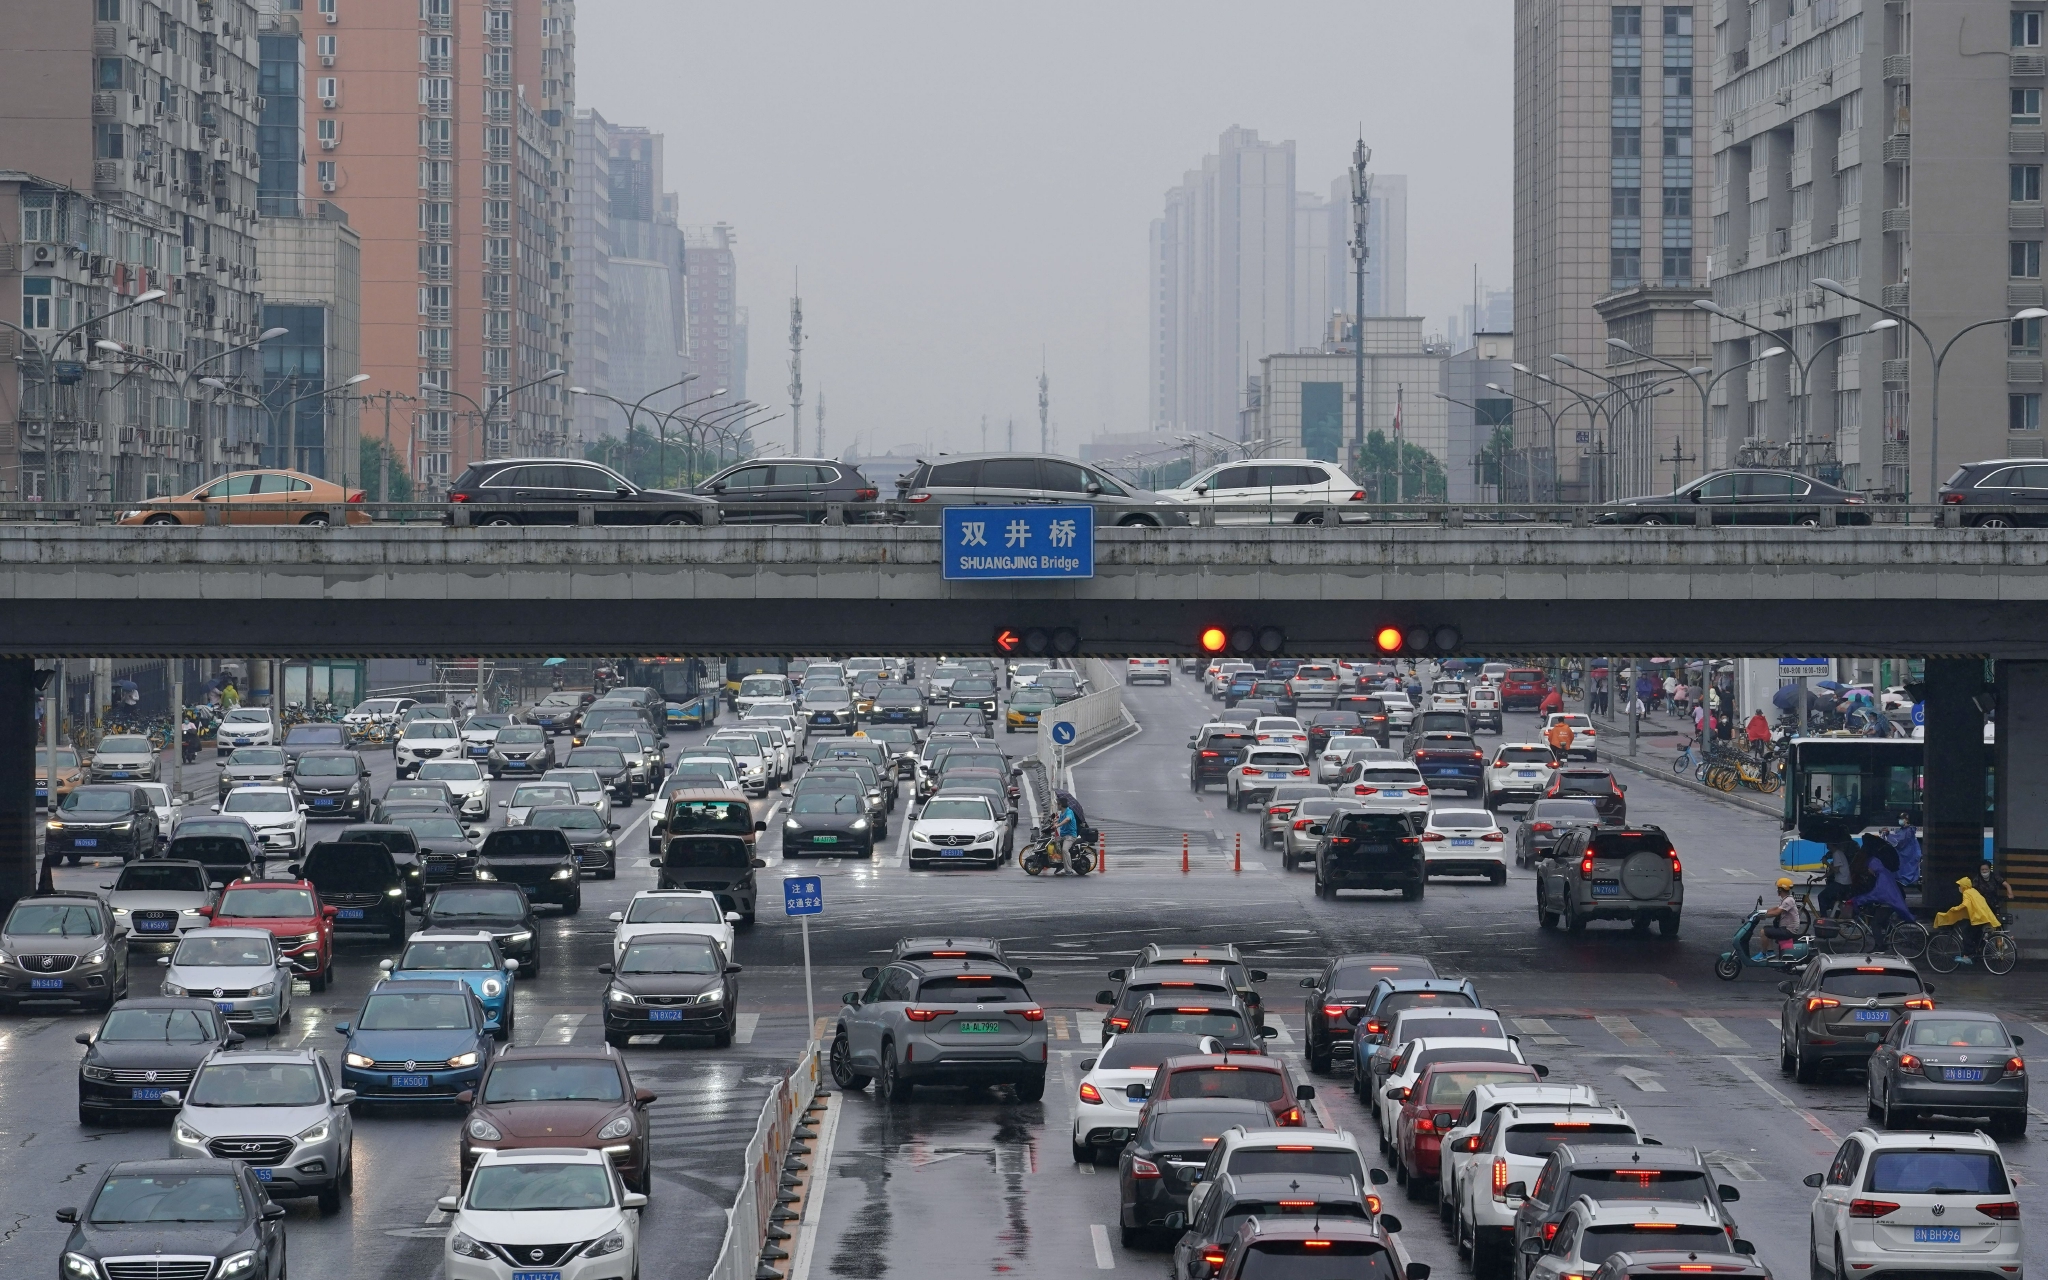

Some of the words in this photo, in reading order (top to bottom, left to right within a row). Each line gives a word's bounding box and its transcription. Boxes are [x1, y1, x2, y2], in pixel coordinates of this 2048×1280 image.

[960, 519, 1077, 548] 双井桥
[959, 556, 1038, 570] SHUANGJING
[1040, 555, 1080, 571] Bridge
[791, 883, 815, 894] 注意
[787, 896, 821, 909] 交通安全
